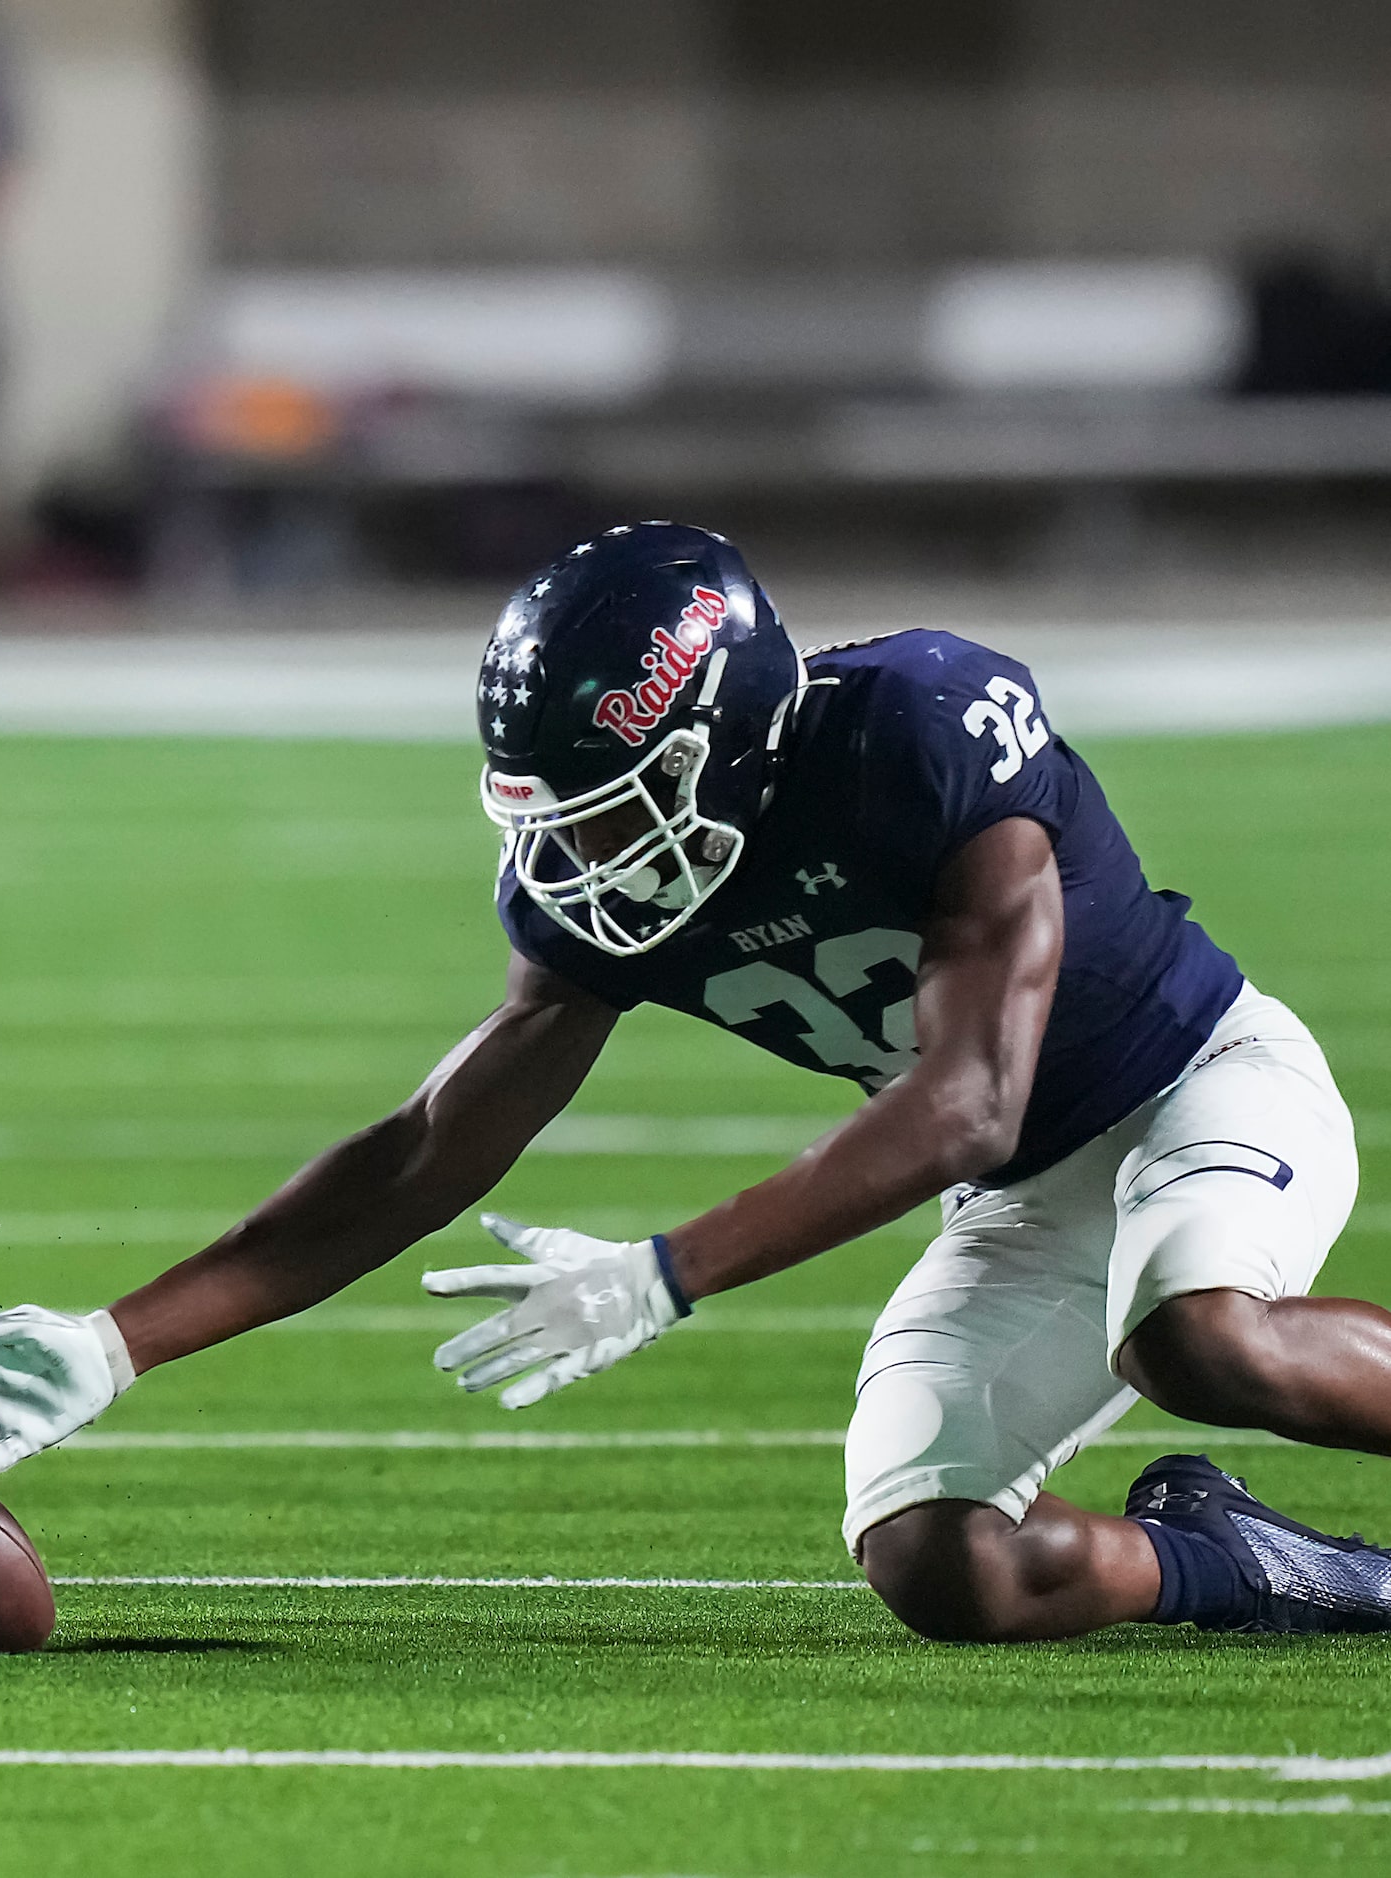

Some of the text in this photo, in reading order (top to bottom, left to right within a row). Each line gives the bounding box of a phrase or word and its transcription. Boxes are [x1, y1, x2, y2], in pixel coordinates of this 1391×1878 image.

[593, 585, 728, 747] Raiders
[962, 675, 1049, 784] 32
[728, 914, 814, 952] RYAN
